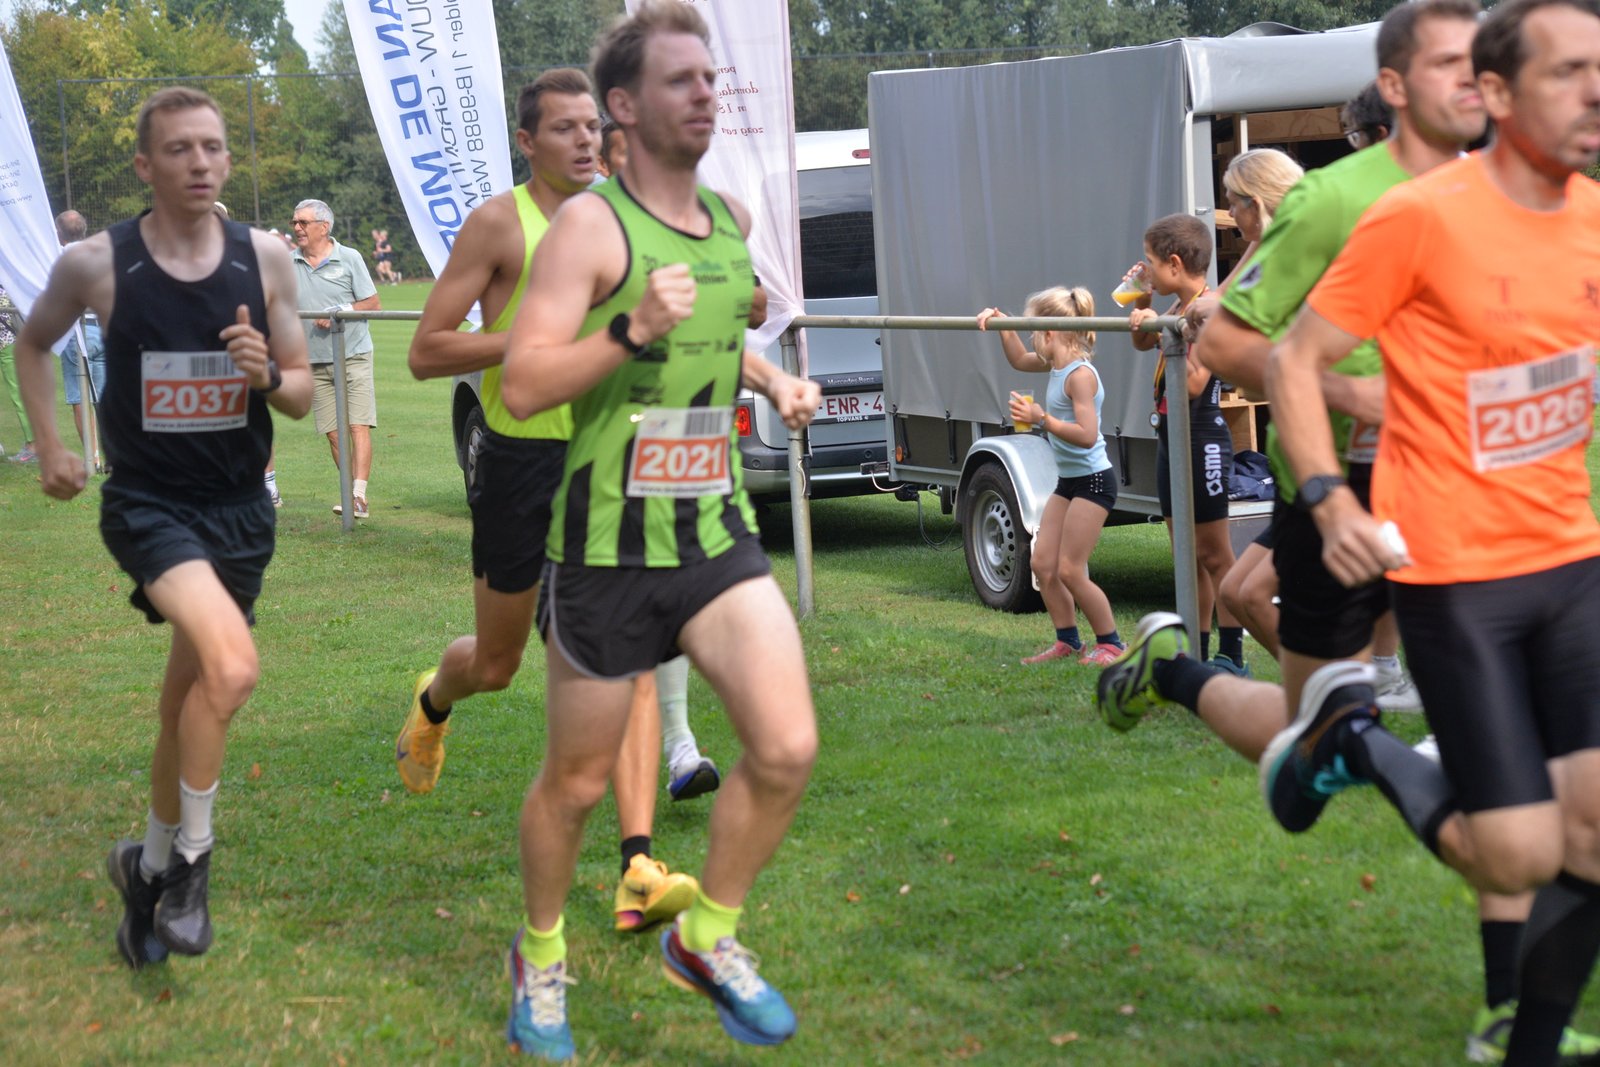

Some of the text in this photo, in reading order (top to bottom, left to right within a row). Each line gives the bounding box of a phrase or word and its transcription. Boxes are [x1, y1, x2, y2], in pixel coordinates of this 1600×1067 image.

[150, 384, 243, 415] 2037
[1482, 385, 1587, 447] 2026
[638, 442, 722, 479] 2021
